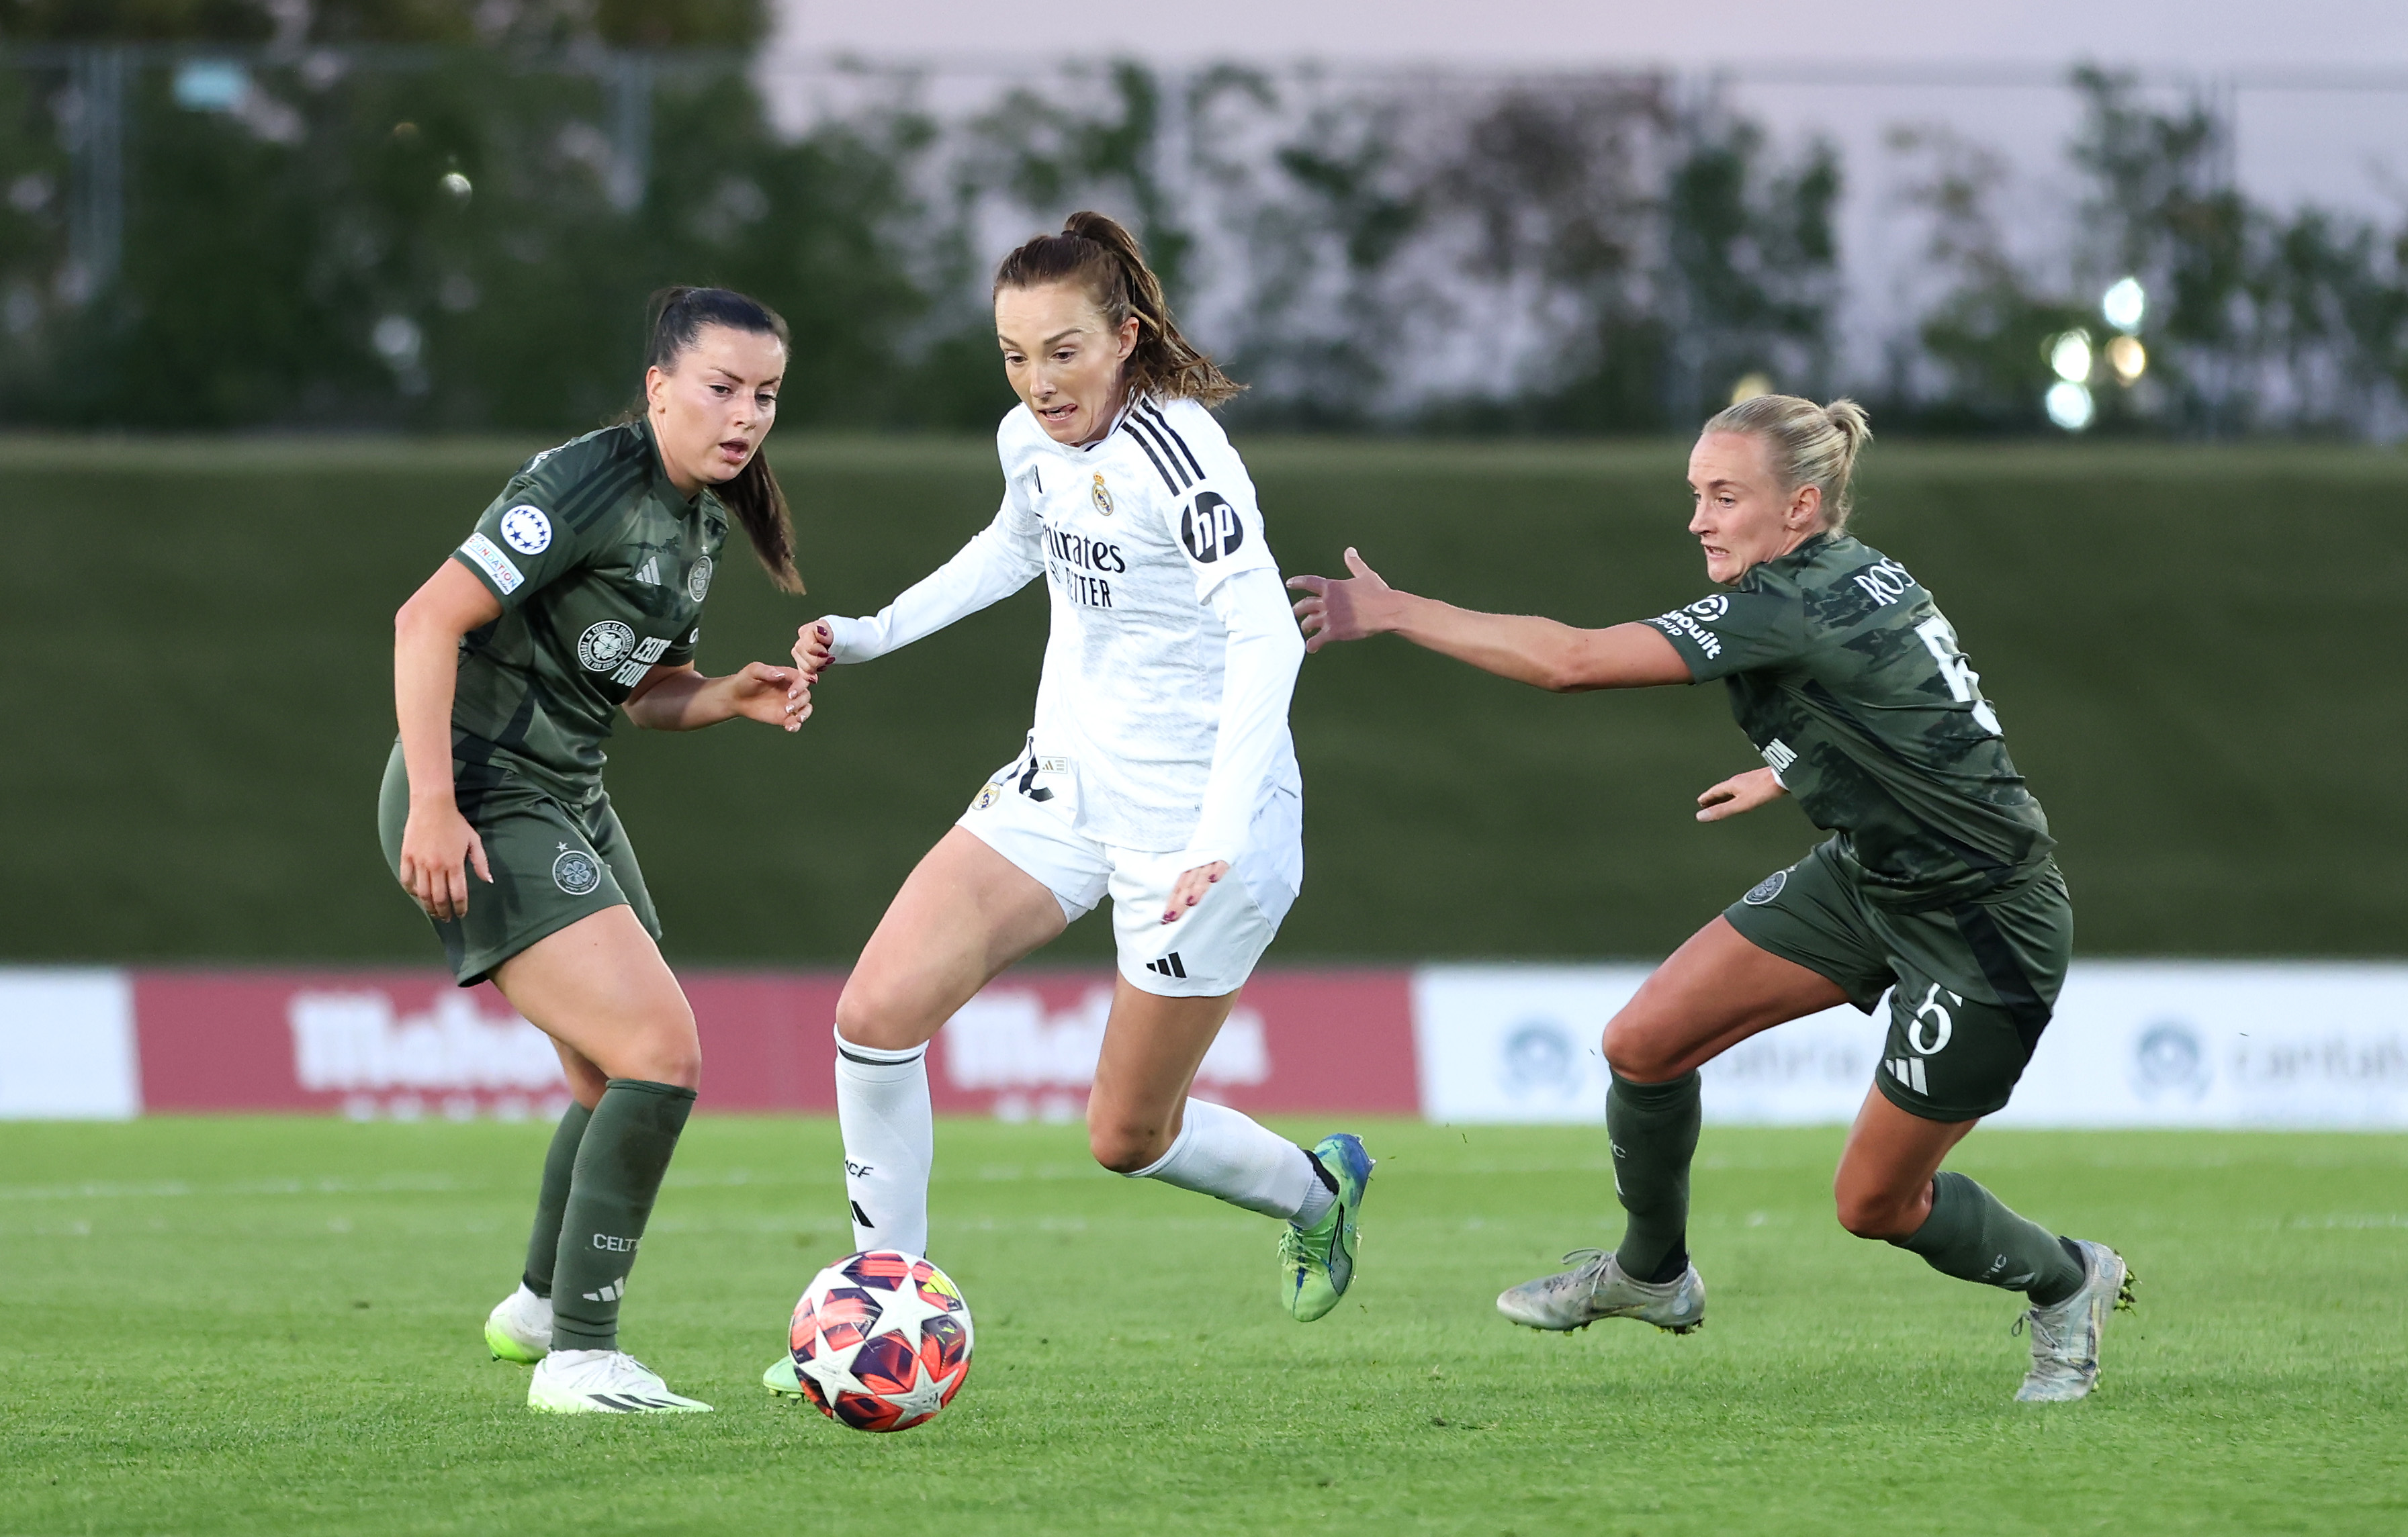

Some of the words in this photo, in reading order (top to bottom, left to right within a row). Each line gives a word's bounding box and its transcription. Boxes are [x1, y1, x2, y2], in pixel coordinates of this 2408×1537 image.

[1035, 512, 1126, 573] mirates
[1188, 495, 1236, 561] hp
[469, 539, 518, 588] FOUNDATION
[593, 1233, 637, 1252] CELT
